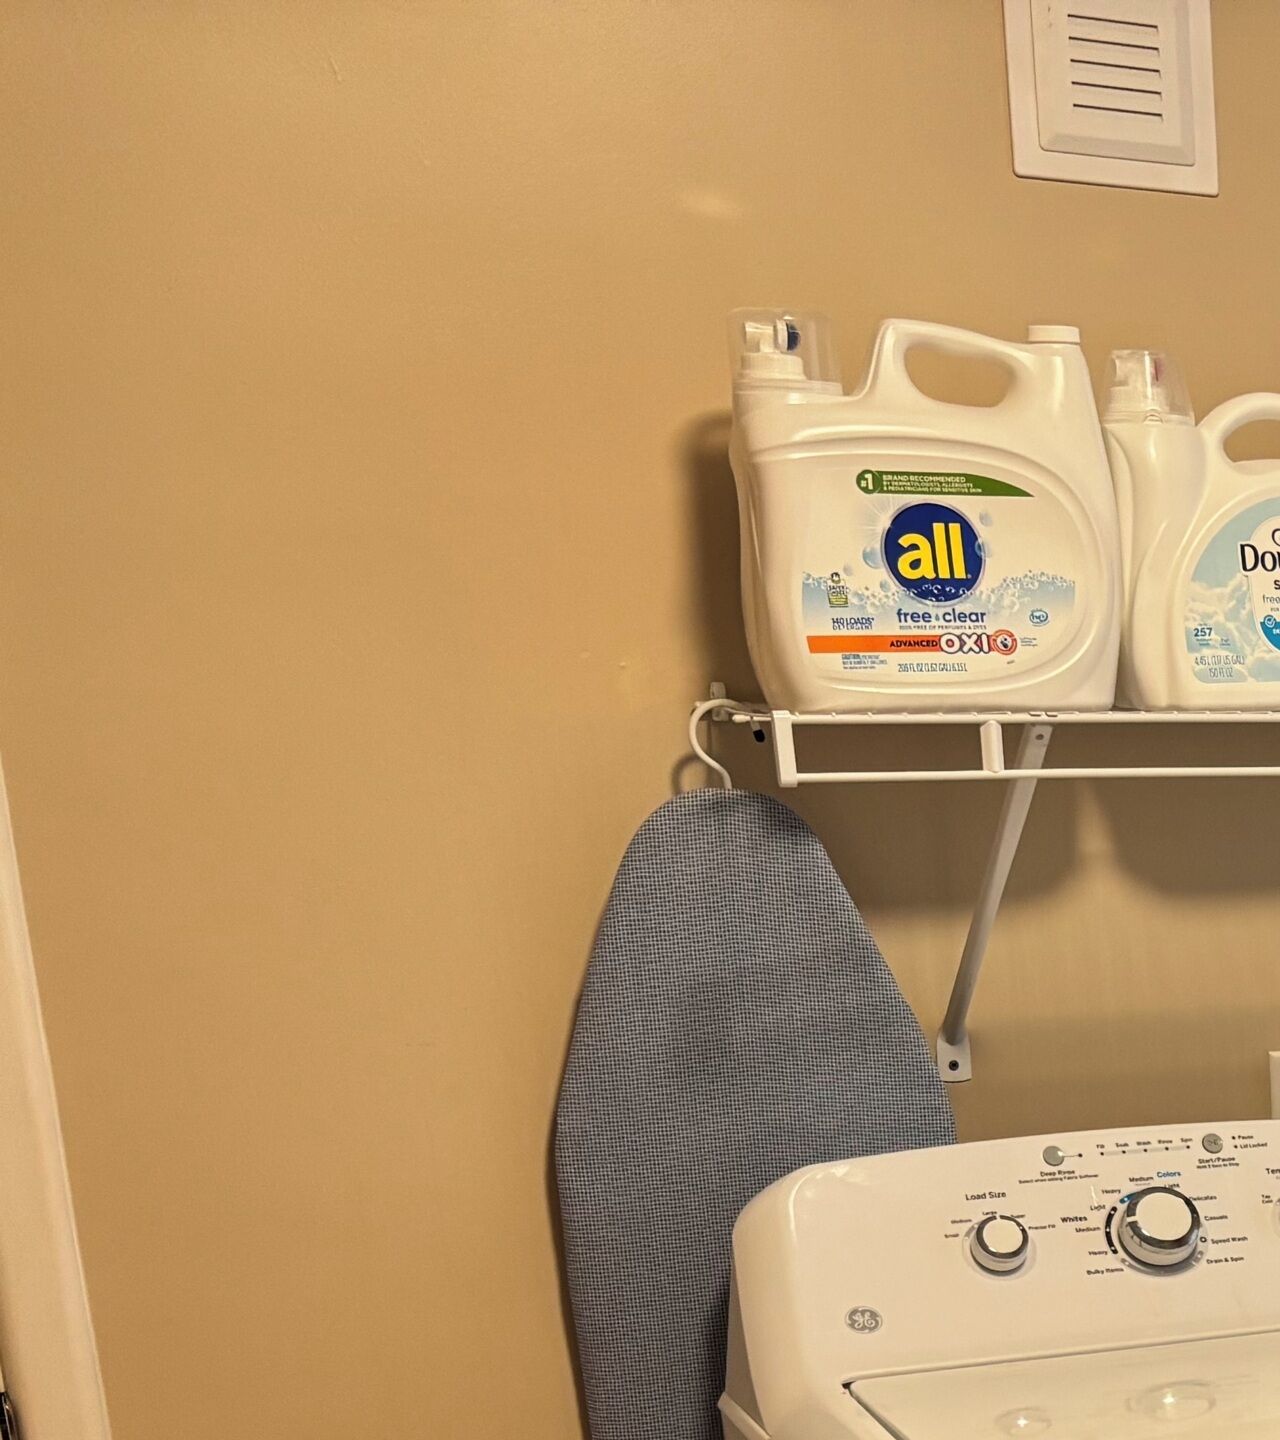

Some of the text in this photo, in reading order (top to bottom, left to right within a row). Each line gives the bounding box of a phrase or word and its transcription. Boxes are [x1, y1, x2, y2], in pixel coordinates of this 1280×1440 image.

[861, 473, 874, 490] #1
[897, 522, 967, 580] all
[1262, 594, 1280, 604] free
[896, 609, 932, 623] free
[942, 608, 986, 623] clear
[1193, 627, 1213, 637] 257
[889, 632, 991, 655] ADVANCED OXI
[1198, 1156, 1236, 1164] Start/Pause
[965, 1191, 1007, 1201] Load Size
